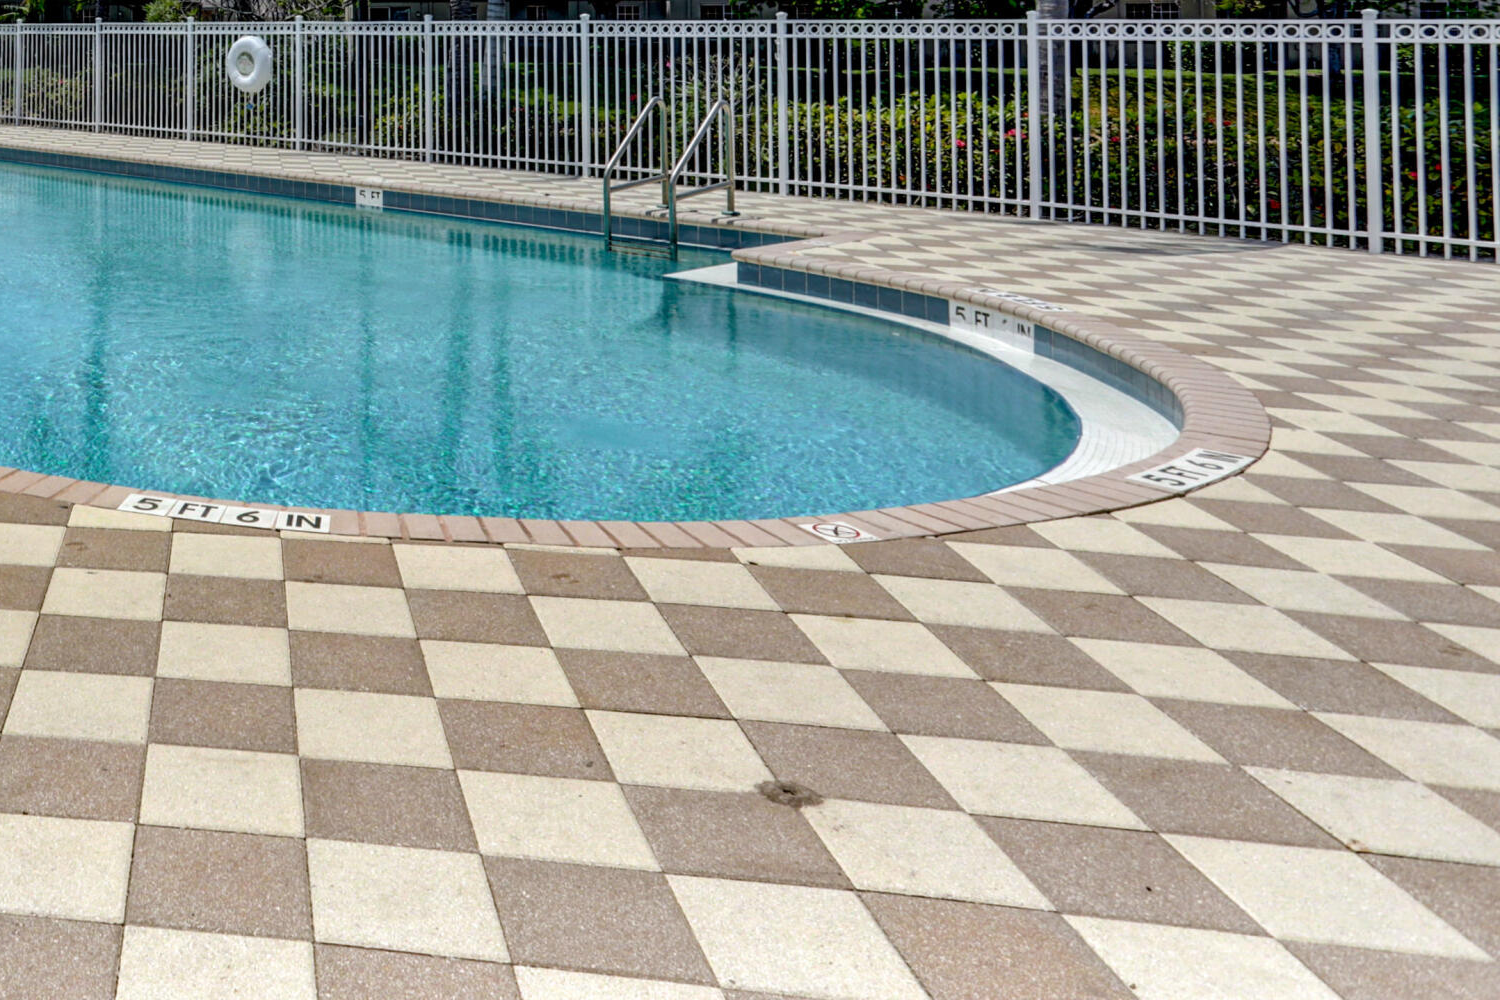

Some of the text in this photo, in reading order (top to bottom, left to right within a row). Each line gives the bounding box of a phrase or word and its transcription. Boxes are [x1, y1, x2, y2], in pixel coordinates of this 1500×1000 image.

[371, 190, 381, 199] FT
[955, 305, 966, 321] 5
[974, 310, 990, 328] FT
[1017, 322, 1031, 338] IN
[1141, 450, 1245, 486] 5 FT 6 IN
[132, 497, 322, 530] 5 FT 6 IN
